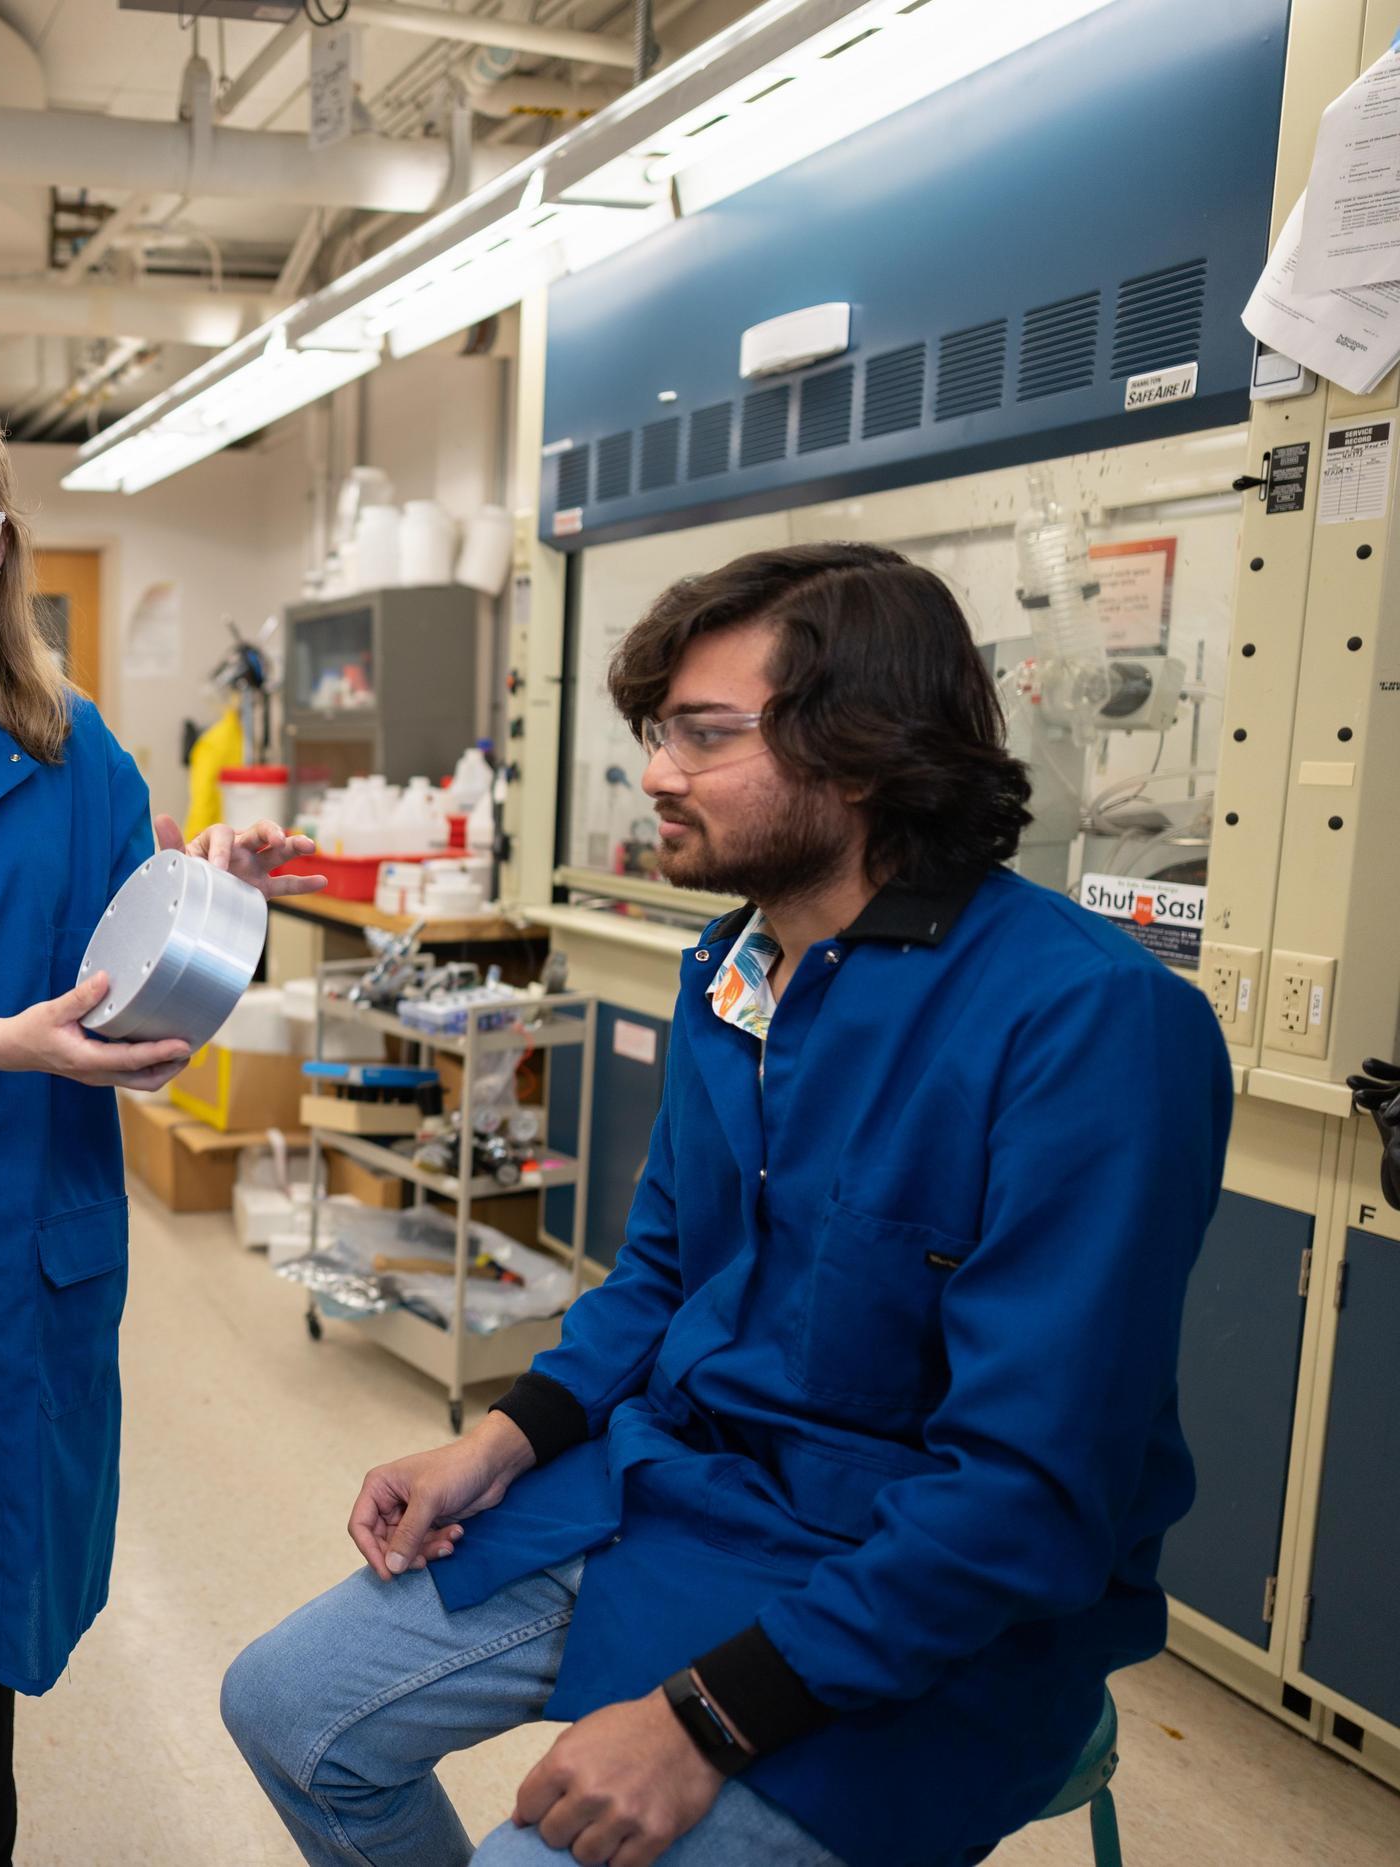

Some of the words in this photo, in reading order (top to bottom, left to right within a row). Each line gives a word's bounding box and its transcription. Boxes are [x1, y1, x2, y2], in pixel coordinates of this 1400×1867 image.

[1181, 378, 1191, 394] II
[1344, 427, 1373, 439] SERVICE
[1344, 435, 1372, 446] RECORD
[1086, 883, 1135, 911] Shut
[1359, 1203, 1377, 1224] F
